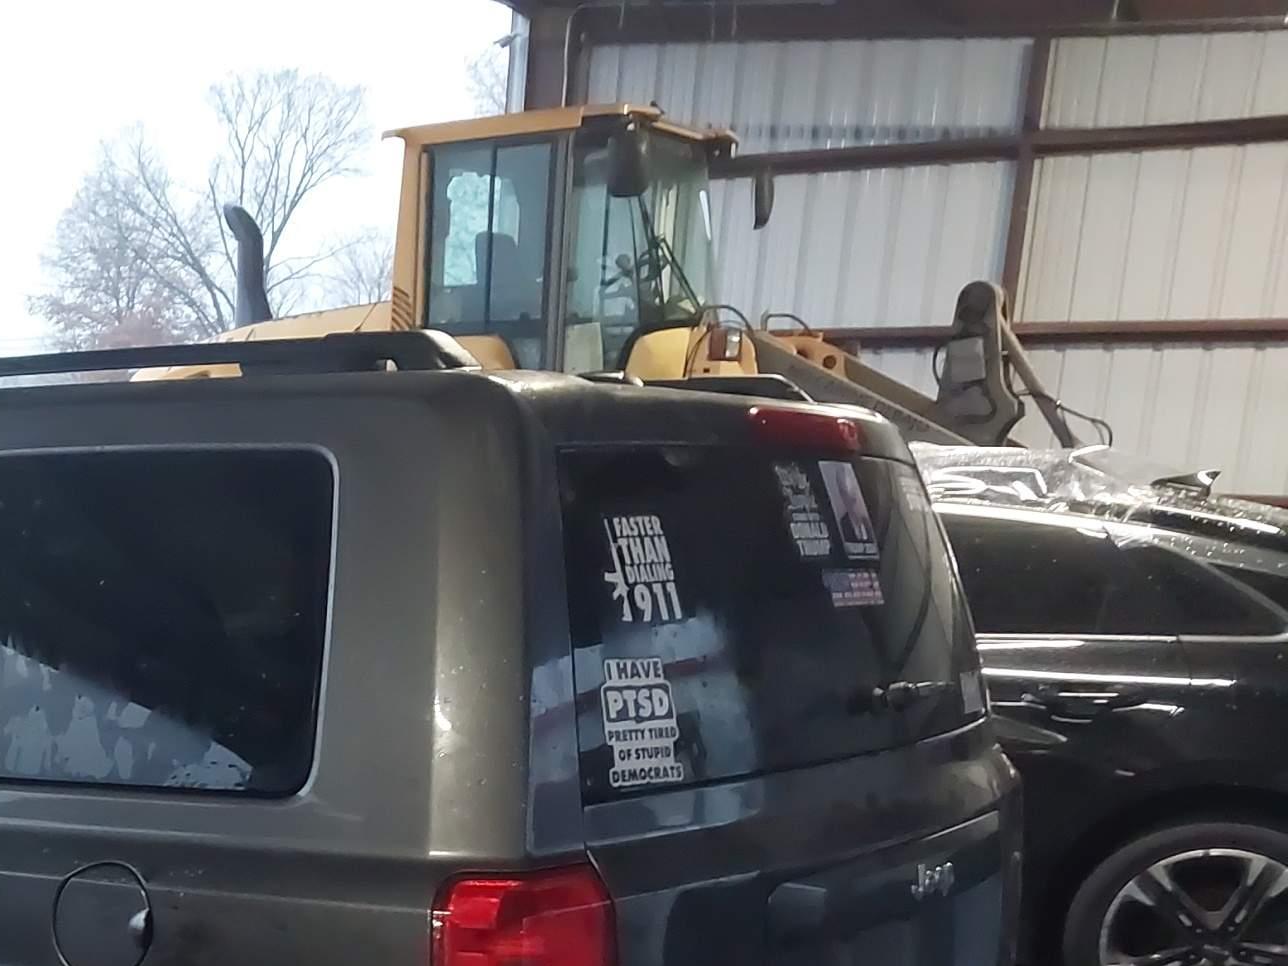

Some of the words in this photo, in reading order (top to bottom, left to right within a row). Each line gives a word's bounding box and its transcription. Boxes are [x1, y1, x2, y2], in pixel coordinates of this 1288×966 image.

[613, 516, 663, 537] FASTER
[618, 536, 671, 564] THAN
[625, 564, 675, 584] DIALING
[606, 661, 613, 680] I
[616, 660, 662, 680] HAVE
[606, 689, 669, 719] PTSD
[608, 729, 645, 742] PRETTY
[647, 727, 676, 741] TIRED
[618, 748, 632, 761] OF
[634, 746, 672, 760] STUPID
[612, 766, 681, 784] DEMOCRATS
[911, 861, 954, 901] Jeep
